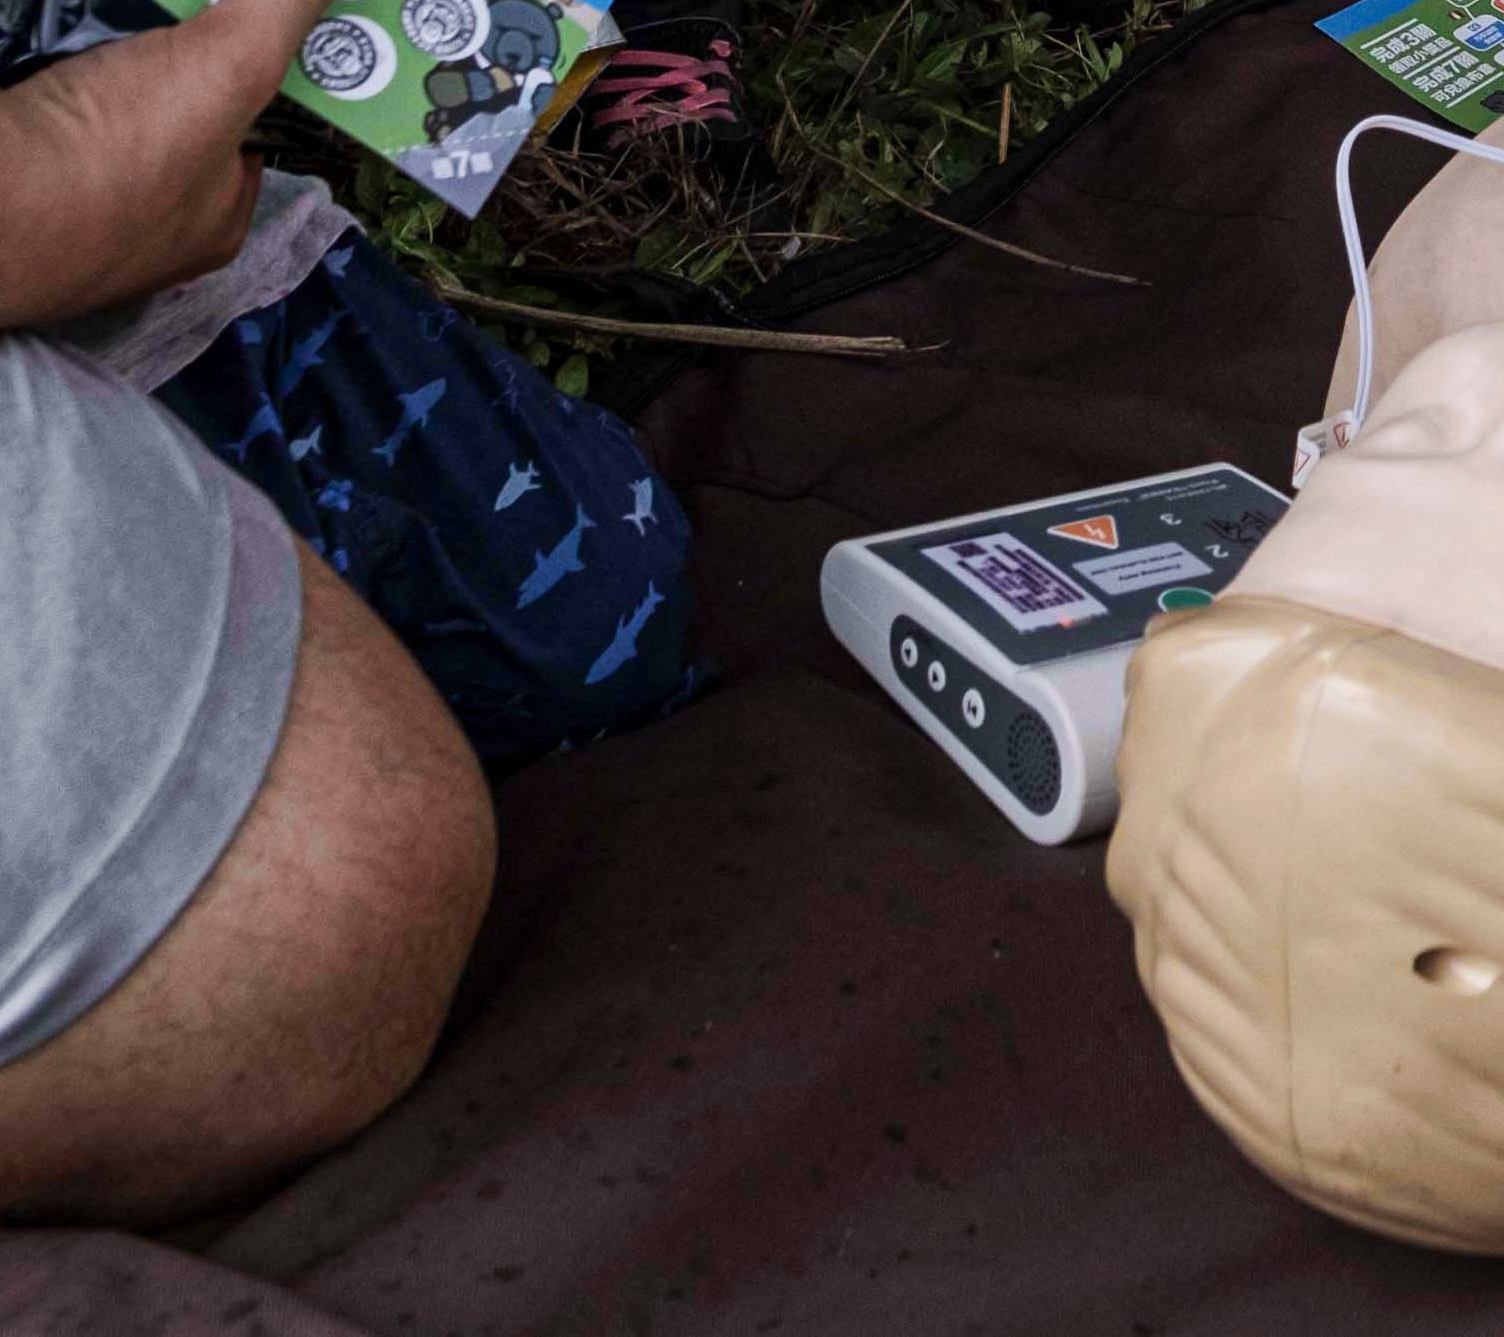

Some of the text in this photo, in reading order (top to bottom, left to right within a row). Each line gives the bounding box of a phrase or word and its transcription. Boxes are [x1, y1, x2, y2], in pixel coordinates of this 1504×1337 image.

[1368, 22, 1438, 63] 完成3關
[1411, 50, 1481, 93] 完成7關
[1159, 512, 1183, 527] 3
[1203, 543, 1230, 559] 2
